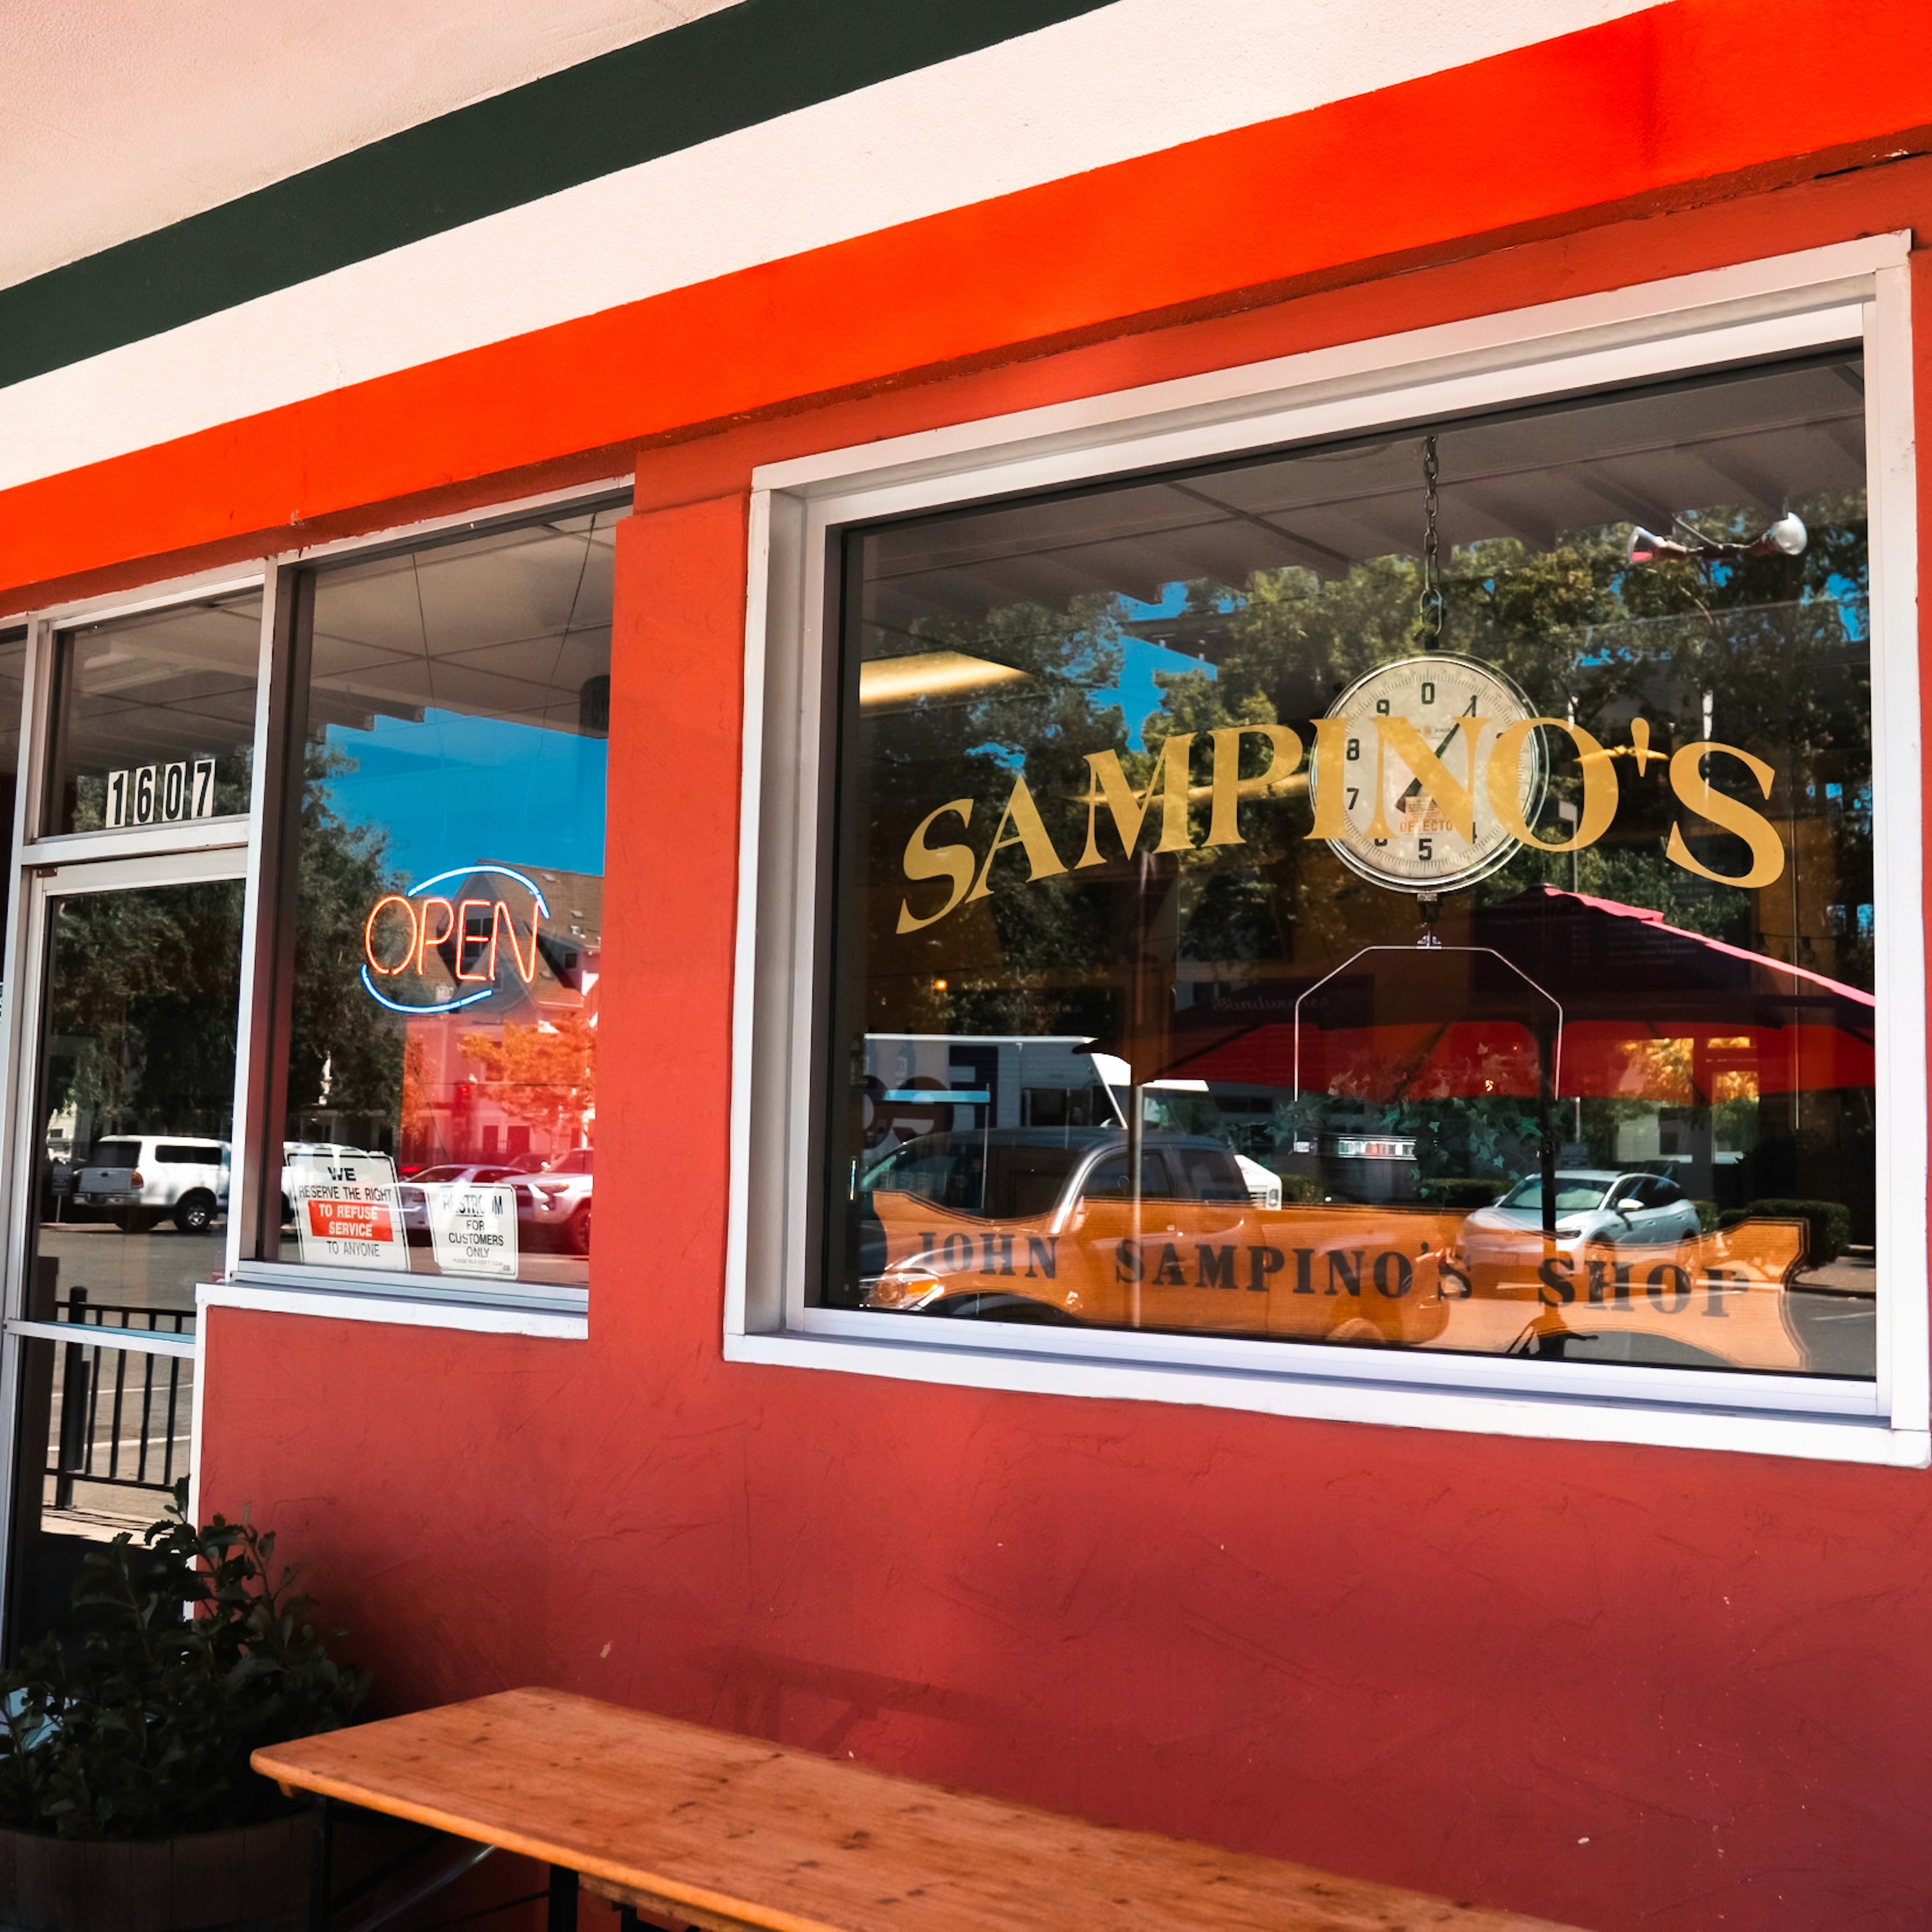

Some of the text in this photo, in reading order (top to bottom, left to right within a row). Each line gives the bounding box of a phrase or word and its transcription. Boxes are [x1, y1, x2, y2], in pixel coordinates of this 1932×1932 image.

[1346, 738, 1360, 761] 8
[113, 762, 213, 825] 1607
[1346, 787, 1359, 810] 7
[896, 716, 1786, 934] SAMPINO'S
[1399, 819, 1453, 832] DEECTO
[1418, 838, 1432, 860] 5
[365, 895, 541, 984] OPEN
[328, 1167, 356, 1181] WE
[299, 1186, 392, 1201] RESERVE THE RIGHT
[319, 1203, 378, 1220] TO REFUSE
[442, 1194, 503, 1215] RSTROM
[328, 1221, 373, 1238] SERVICE
[466, 1220, 484, 1231] FOR
[327, 1240, 381, 1257] TO ANYONE
[448, 1233, 504, 1247] CUSTOMERS
[466, 1246, 489, 1258] ONLY
[918, 1232, 1750, 1318] JOHN SAMPINO'S SHOP
